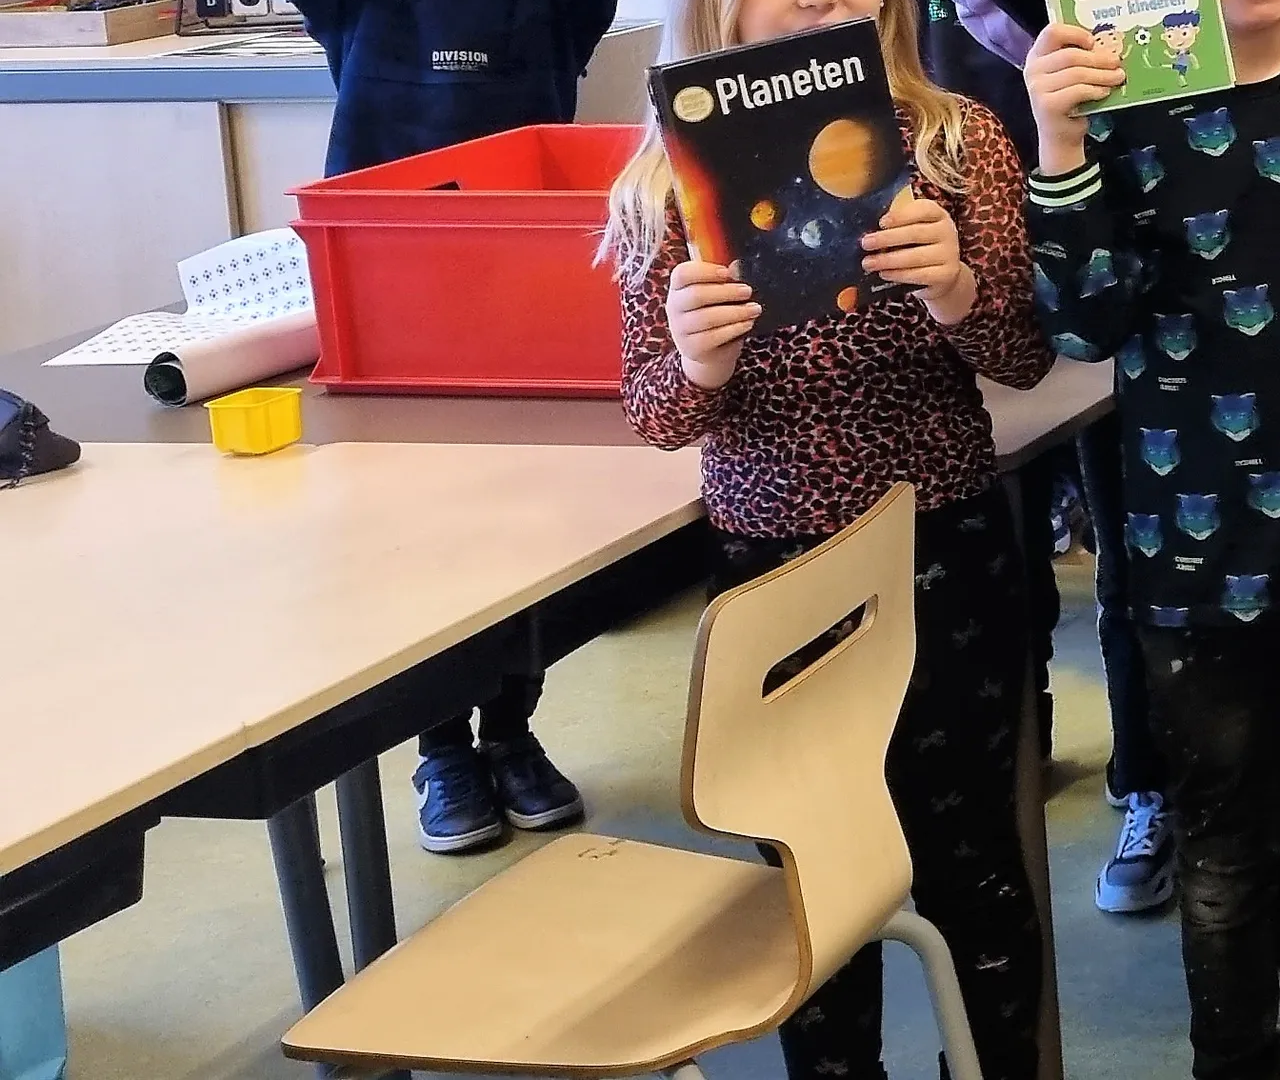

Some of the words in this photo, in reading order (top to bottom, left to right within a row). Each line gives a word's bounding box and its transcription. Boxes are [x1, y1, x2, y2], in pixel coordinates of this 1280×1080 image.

[1092, 4, 1123, 20] voor
[432, 50, 488, 63] DIVISION
[715, 55, 865, 116] Planeten
